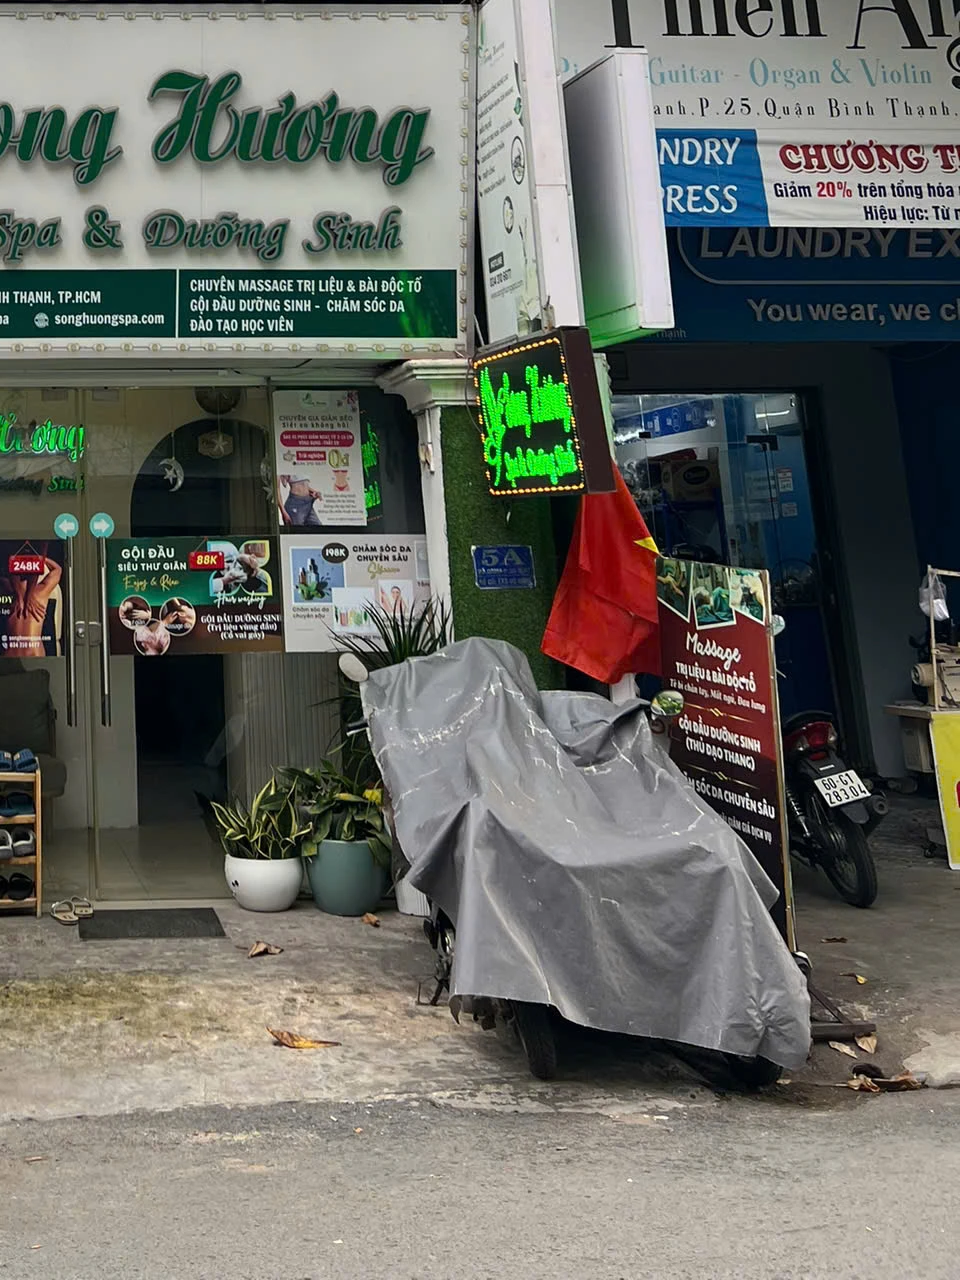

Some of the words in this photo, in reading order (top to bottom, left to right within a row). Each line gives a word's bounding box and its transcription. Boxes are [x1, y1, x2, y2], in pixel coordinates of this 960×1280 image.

[648, 58, 723, 86] Guitar
[750, 57, 821, 93] Organ
[831, 58, 852, 84] &
[859, 58, 932, 85] Violin
[147, 69, 435, 187] Hương
[659, 136, 741, 166] NDRY
[779, 137, 929, 175] CHƯƠNG
[774, 183, 812, 200] Giảm
[816, 181, 852, 198] 20%
[857, 183, 887, 198] trên
[891, 180, 923, 201] tổng
[864, 204, 897, 223] Hiệu
[901, 205, 929, 223] lực:
[932, 204, 952, 221] Từ
[83, 204, 124, 253] &
[144, 208, 290, 261] Dưỡng
[303, 204, 404, 255] Sinh
[701, 228, 896, 258] LAUNDRY
[190, 275, 234, 292] CHUYÊN
[239, 279, 293, 292] MASSAGE
[297, 279, 315, 295] TRỊ
[319, 276, 343, 295] LIỆU
[346, 280, 356, 292] &
[359, 276, 378, 292] BÀI
[381, 277, 404, 295] ĐỘC
[407, 276, 422, 292] TỐ
[13, 291, 55, 306] THẠNH,
[58, 291, 101, 304] TP.HCM
[190, 296, 209, 314] GỘI
[213, 295, 235, 312] ĐẦU
[239, 295, 280, 312] DƯỠNG
[283, 299, 311, 312] SINH
[327, 296, 360, 312] CHĂM
[364, 296, 386, 312] SÓC
[390, 300, 405, 312] DA
[55, 313, 164, 326] songhuongspa.com
[747, 298, 803, 321] You
[807, 302, 885, 326] wear,
[890, 302, 931, 321] we
[190, 316, 212, 332] ĐÀO
[216, 319, 238, 334] TẠO
[241, 319, 264, 334] HỌC
[267, 316, 293, 331] VIÊN
[121, 546, 145, 560] GỘI
[147, 544, 174, 559] ĐẦU
[353, 544, 378, 553] CHĂM
[380, 543, 397, 553] SÓC
[400, 545, 412, 553] DA
[356, 552, 391, 562] CHUYÊN
[392, 552, 408, 562] SÂU
[13, 561, 40, 571] 248K
[117, 561, 138, 572] SIÊU
[140, 561, 160, 571] THƯ
[163, 561, 187, 571] GIÃN
[196, 555, 218, 565] 88K
[481, 549, 524, 567] 5A
[200, 614, 215, 624] GỘI
[217, 612, 233, 623] ĐẦU
[235, 613, 261, 623] DƯỠNG
[685, 631, 741, 671] Massage
[675, 661, 689, 680] TRỊ
[688, 662, 705, 683] LIỆU
[705, 669, 712, 681] &
[712, 666, 727, 685] BÀI
[678, 713, 692, 734] GỘI
[692, 715, 710, 738] ĐẦU
[710, 724, 740, 746] DƯỠNG
[740, 735, 761, 753] SINH
[705, 745, 723, 763] ĐẠO
[724, 748, 755, 772] THANG)
[821, 773, 855, 791] 60-G1
[695, 777, 711, 795] SÓC
[711, 788, 723, 802] DA
[723, 789, 757, 814] CHUYÊN
[757, 797, 776, 820] SÂU
